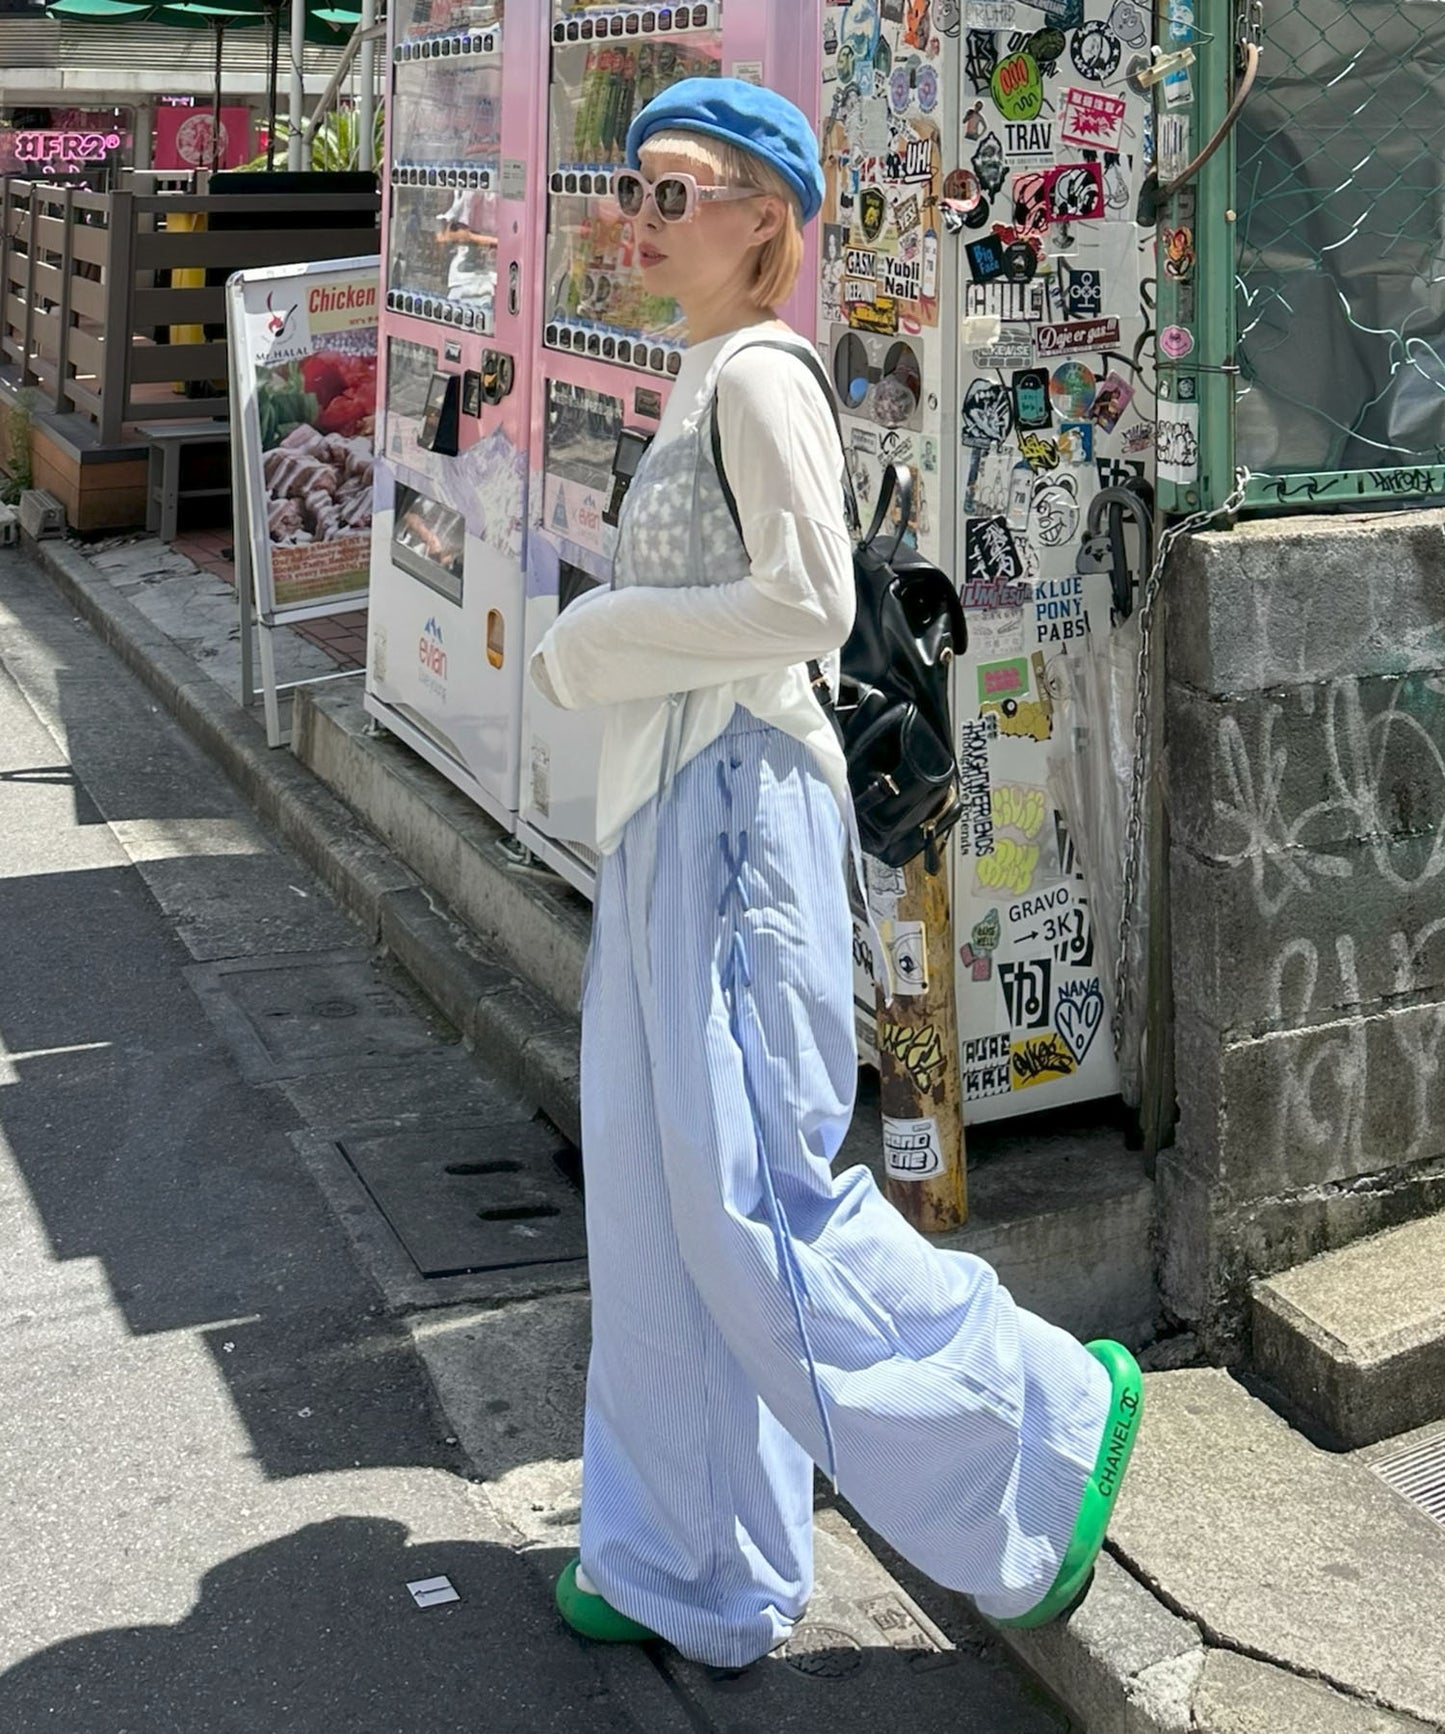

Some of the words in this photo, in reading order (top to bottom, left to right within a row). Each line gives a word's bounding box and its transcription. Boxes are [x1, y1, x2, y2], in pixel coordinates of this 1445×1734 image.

[1004, 123, 1052, 151] TRAV
[905, 139, 932, 174] UH!
[885, 257, 920, 280] Yubli
[309, 285, 376, 314] Chicken
[1038, 326, 1073, 350] Daje
[1073, 330, 1086, 343] er
[1036, 577, 1082, 600] KLUE
[1036, 598, 1082, 621] PONY
[1037, 619, 1085, 643] PABS
[419, 637, 447, 680] evian
[1008, 888, 1069, 922] GRAVO
[1043, 912, 1072, 941] 3K
[1058, 977, 1100, 999] NANA
[1097, 1418, 1132, 1498] CHANEL
